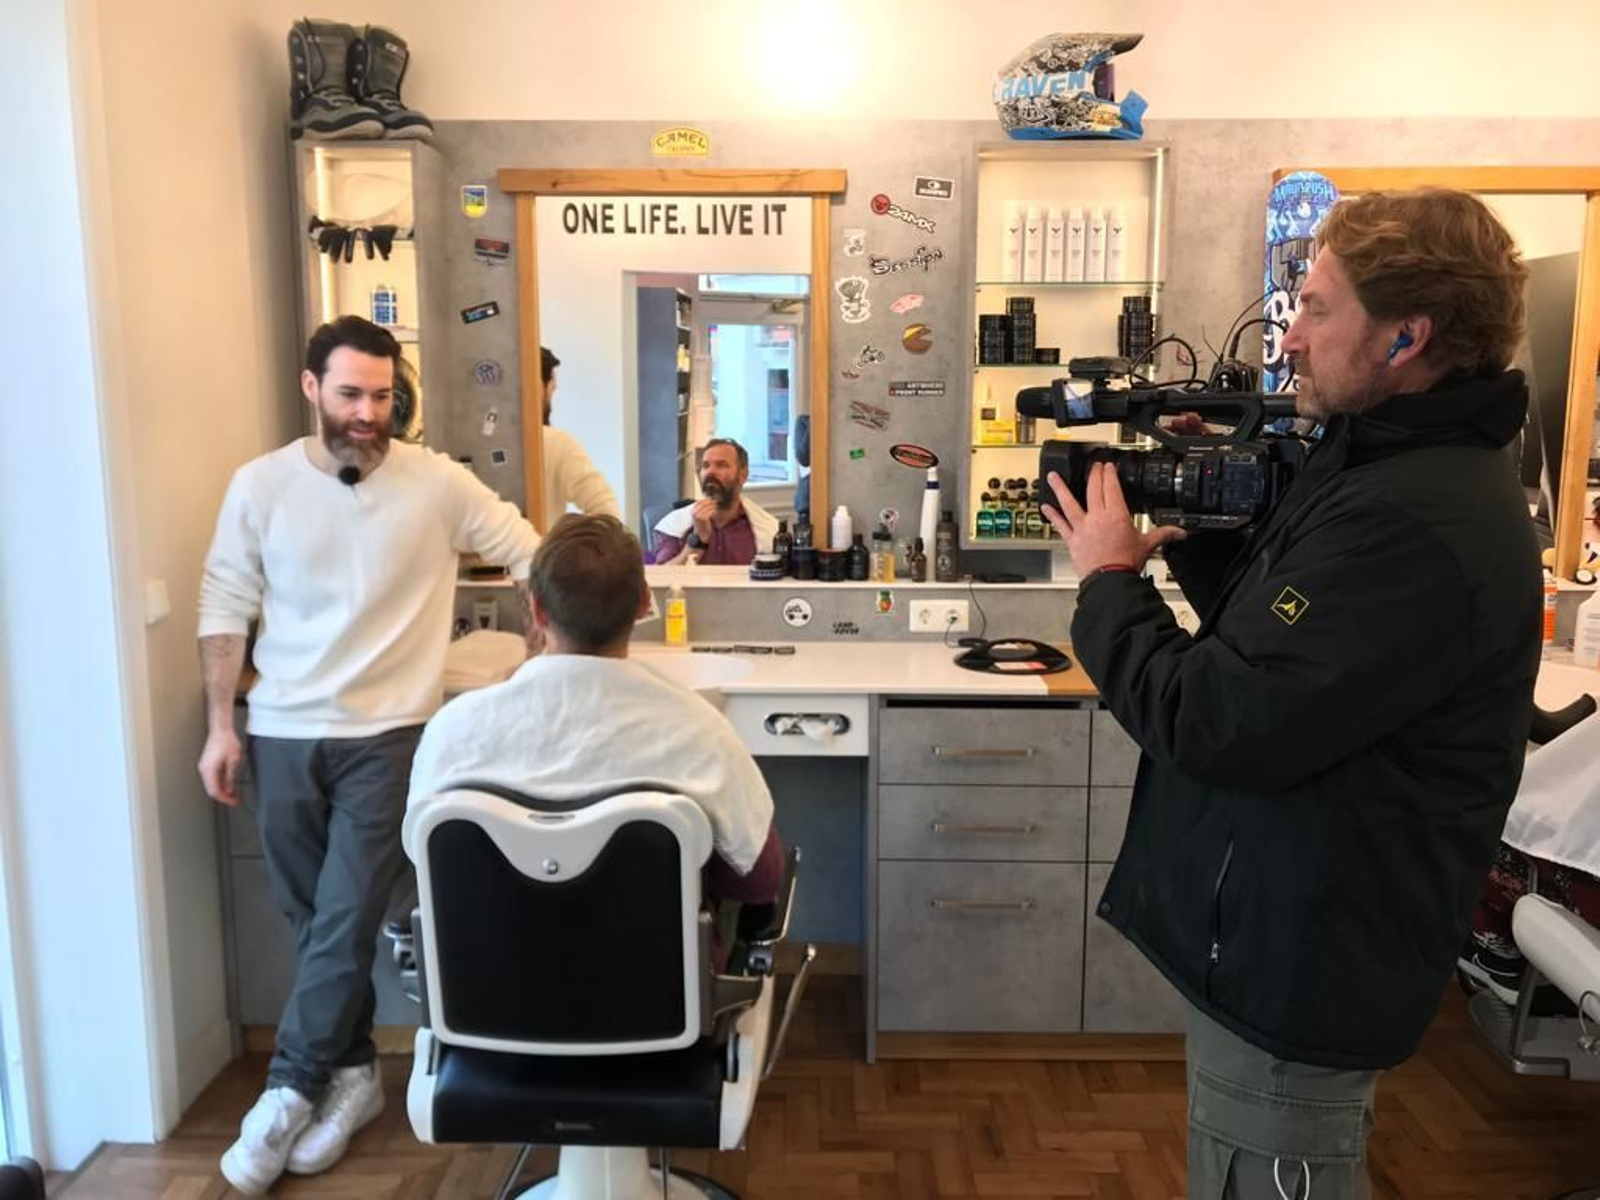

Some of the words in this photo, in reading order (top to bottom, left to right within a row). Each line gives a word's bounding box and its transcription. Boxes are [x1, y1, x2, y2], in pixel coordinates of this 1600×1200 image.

[656, 131, 706, 149] CAMEL
[562, 203, 615, 234] ONE
[623, 203, 687, 234] LIFE.
[696, 203, 754, 235] LIVE
[763, 203, 787, 235] IT
